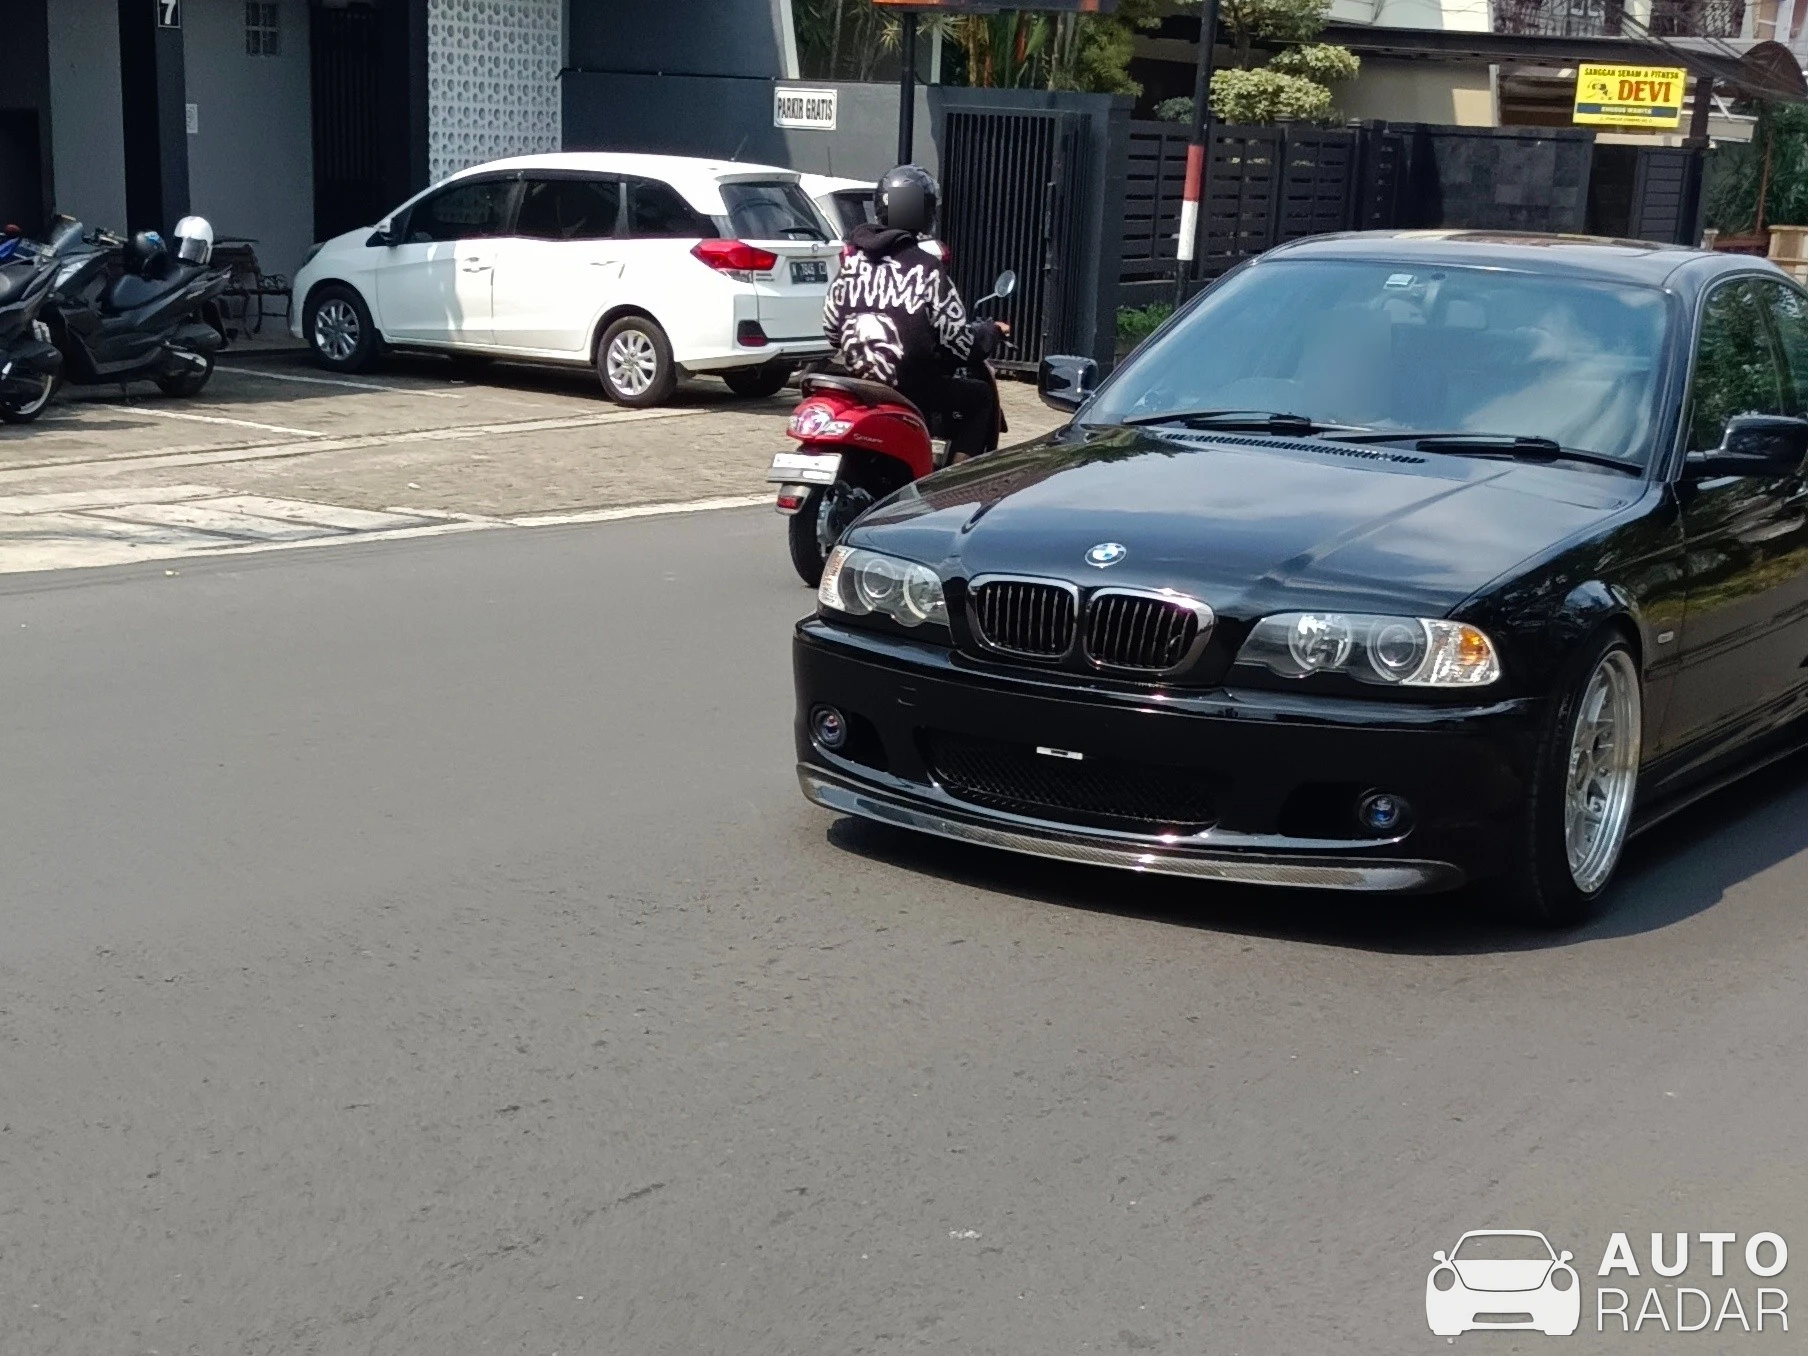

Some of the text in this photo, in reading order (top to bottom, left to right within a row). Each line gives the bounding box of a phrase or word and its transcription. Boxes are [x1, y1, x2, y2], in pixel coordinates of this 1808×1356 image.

[161, 0, 176, 24] 7
[1584, 67, 1616, 77] SANGGAR
[1617, 69, 1642, 78] SENAM
[1617, 79, 1672, 102] DEVI
[777, 97, 833, 121] PARKIR GRATIS
